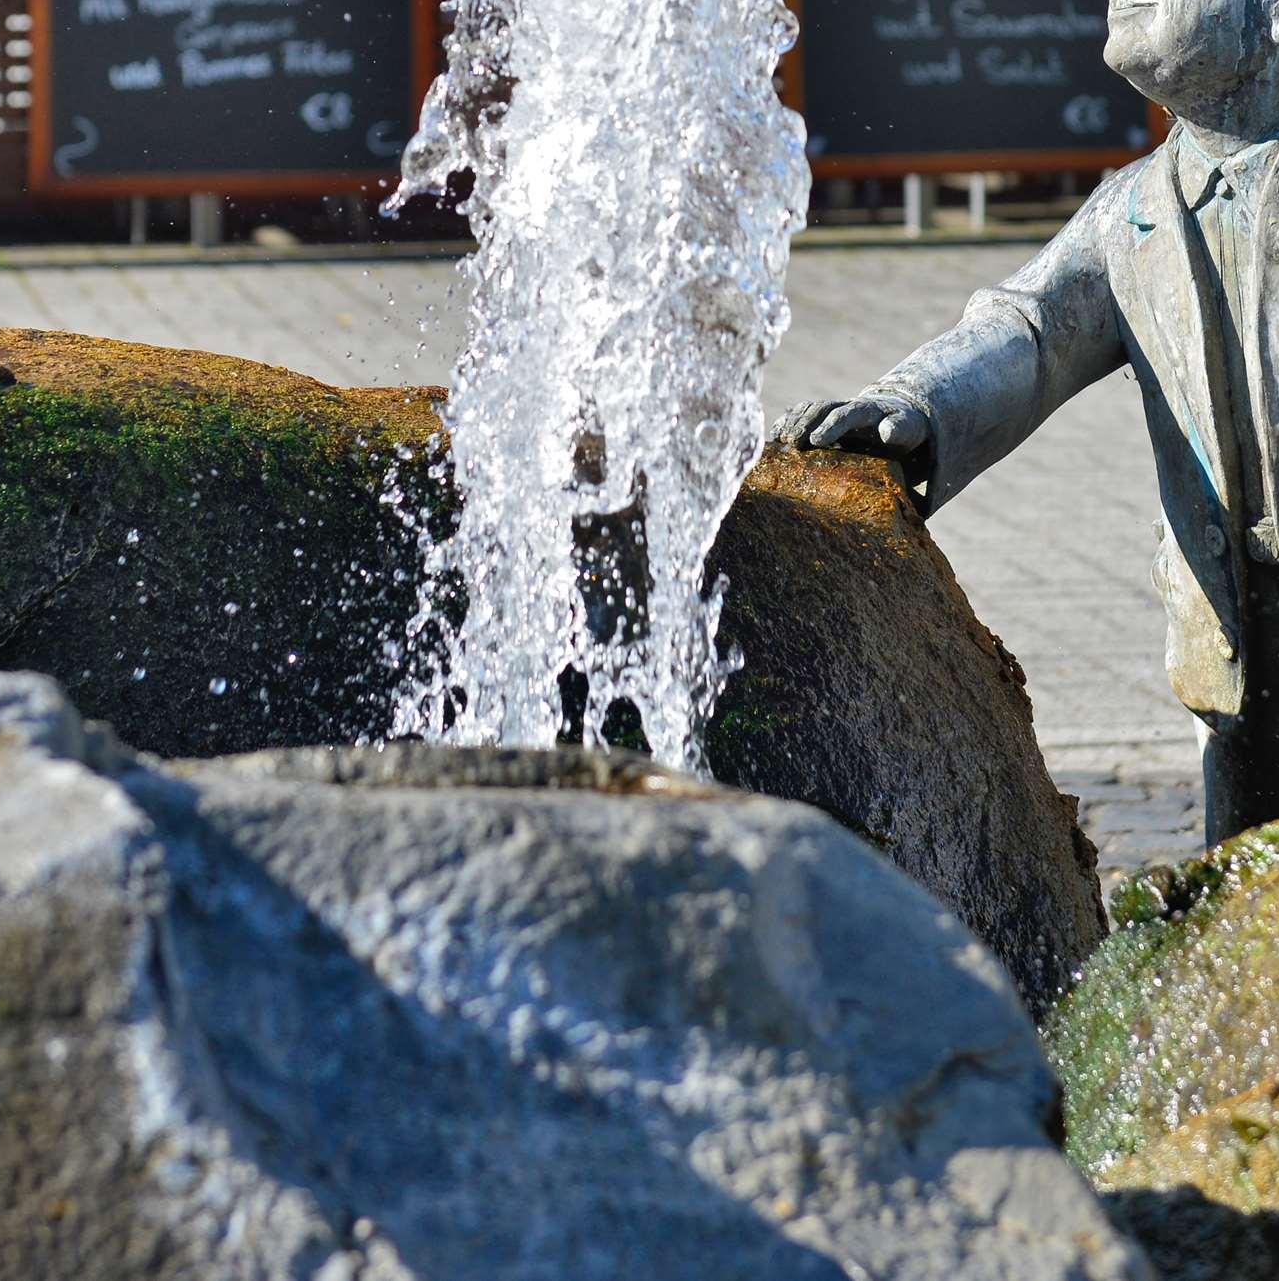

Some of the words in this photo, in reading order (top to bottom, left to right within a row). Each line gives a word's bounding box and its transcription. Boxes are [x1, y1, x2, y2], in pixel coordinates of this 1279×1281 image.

[109, 56, 163, 90] und
[902, 47, 964, 85] und
[977, 46, 1067, 86] Salat
